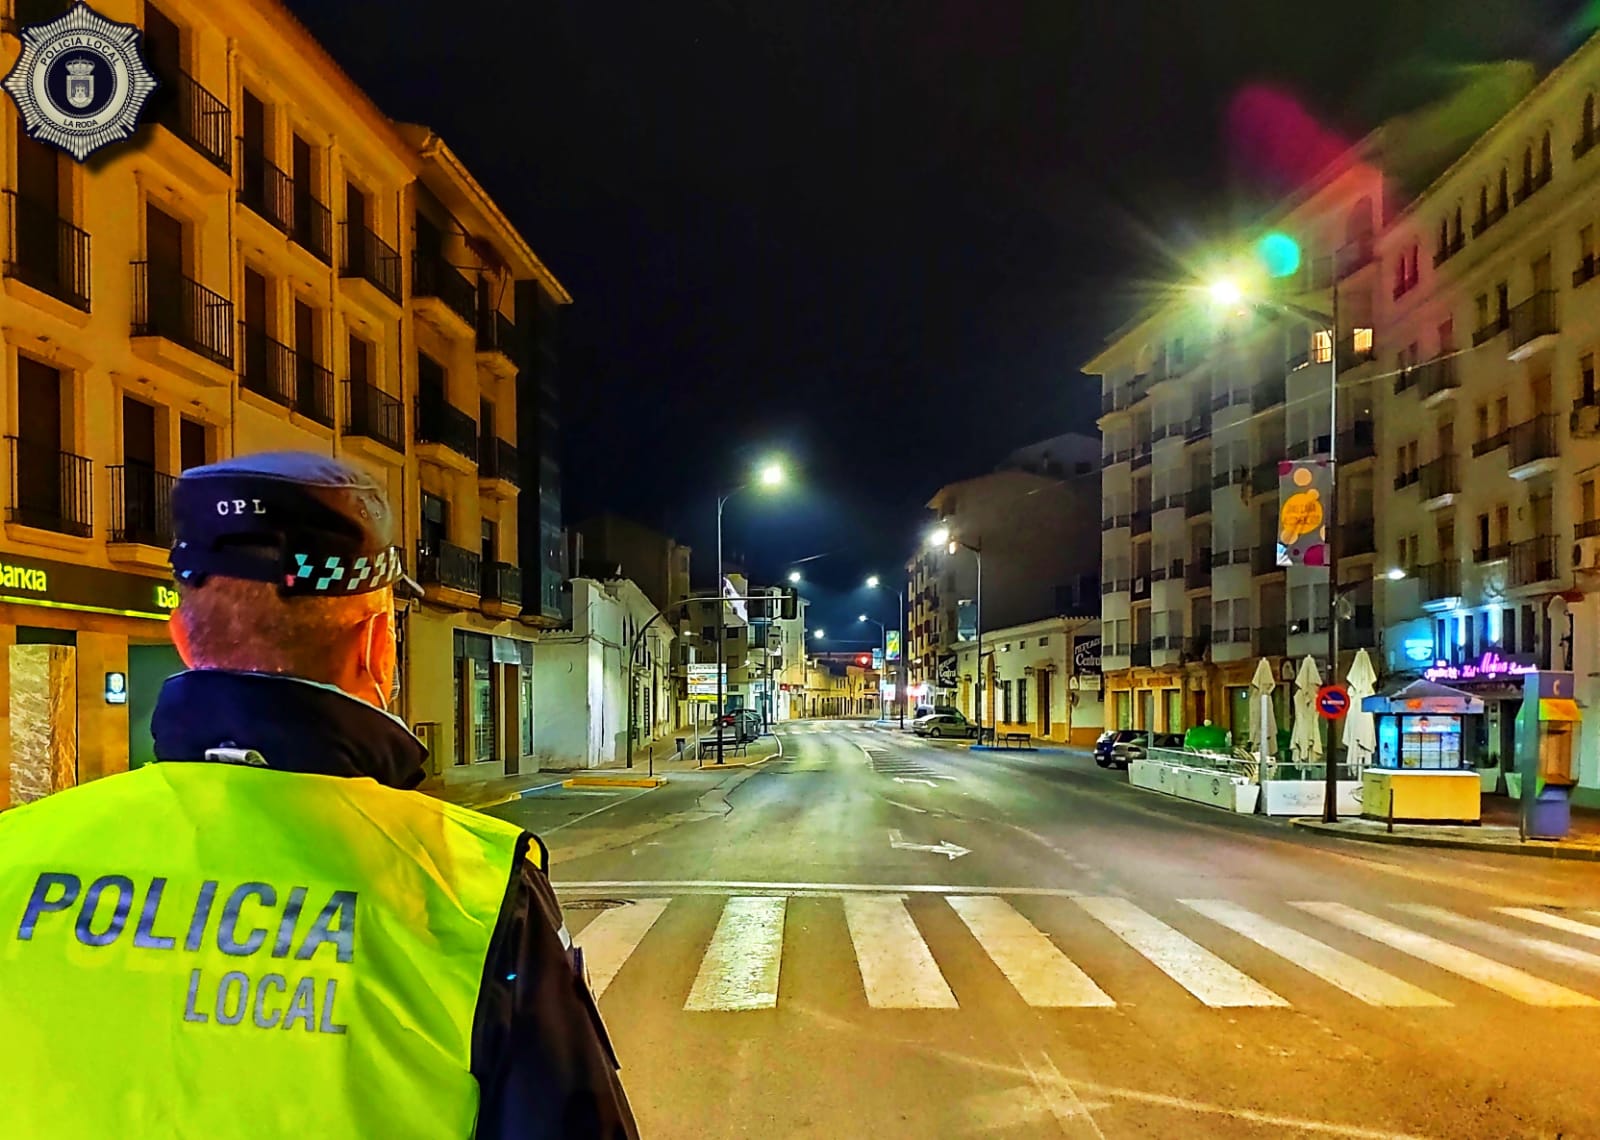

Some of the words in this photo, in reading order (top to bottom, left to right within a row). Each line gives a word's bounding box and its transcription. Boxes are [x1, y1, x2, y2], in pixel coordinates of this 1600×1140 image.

[216, 499, 266, 516] CPL
[1076, 652, 1101, 666] Centra
[16, 872, 358, 963] POLICIA
[183, 968, 347, 1034] LOCAL
